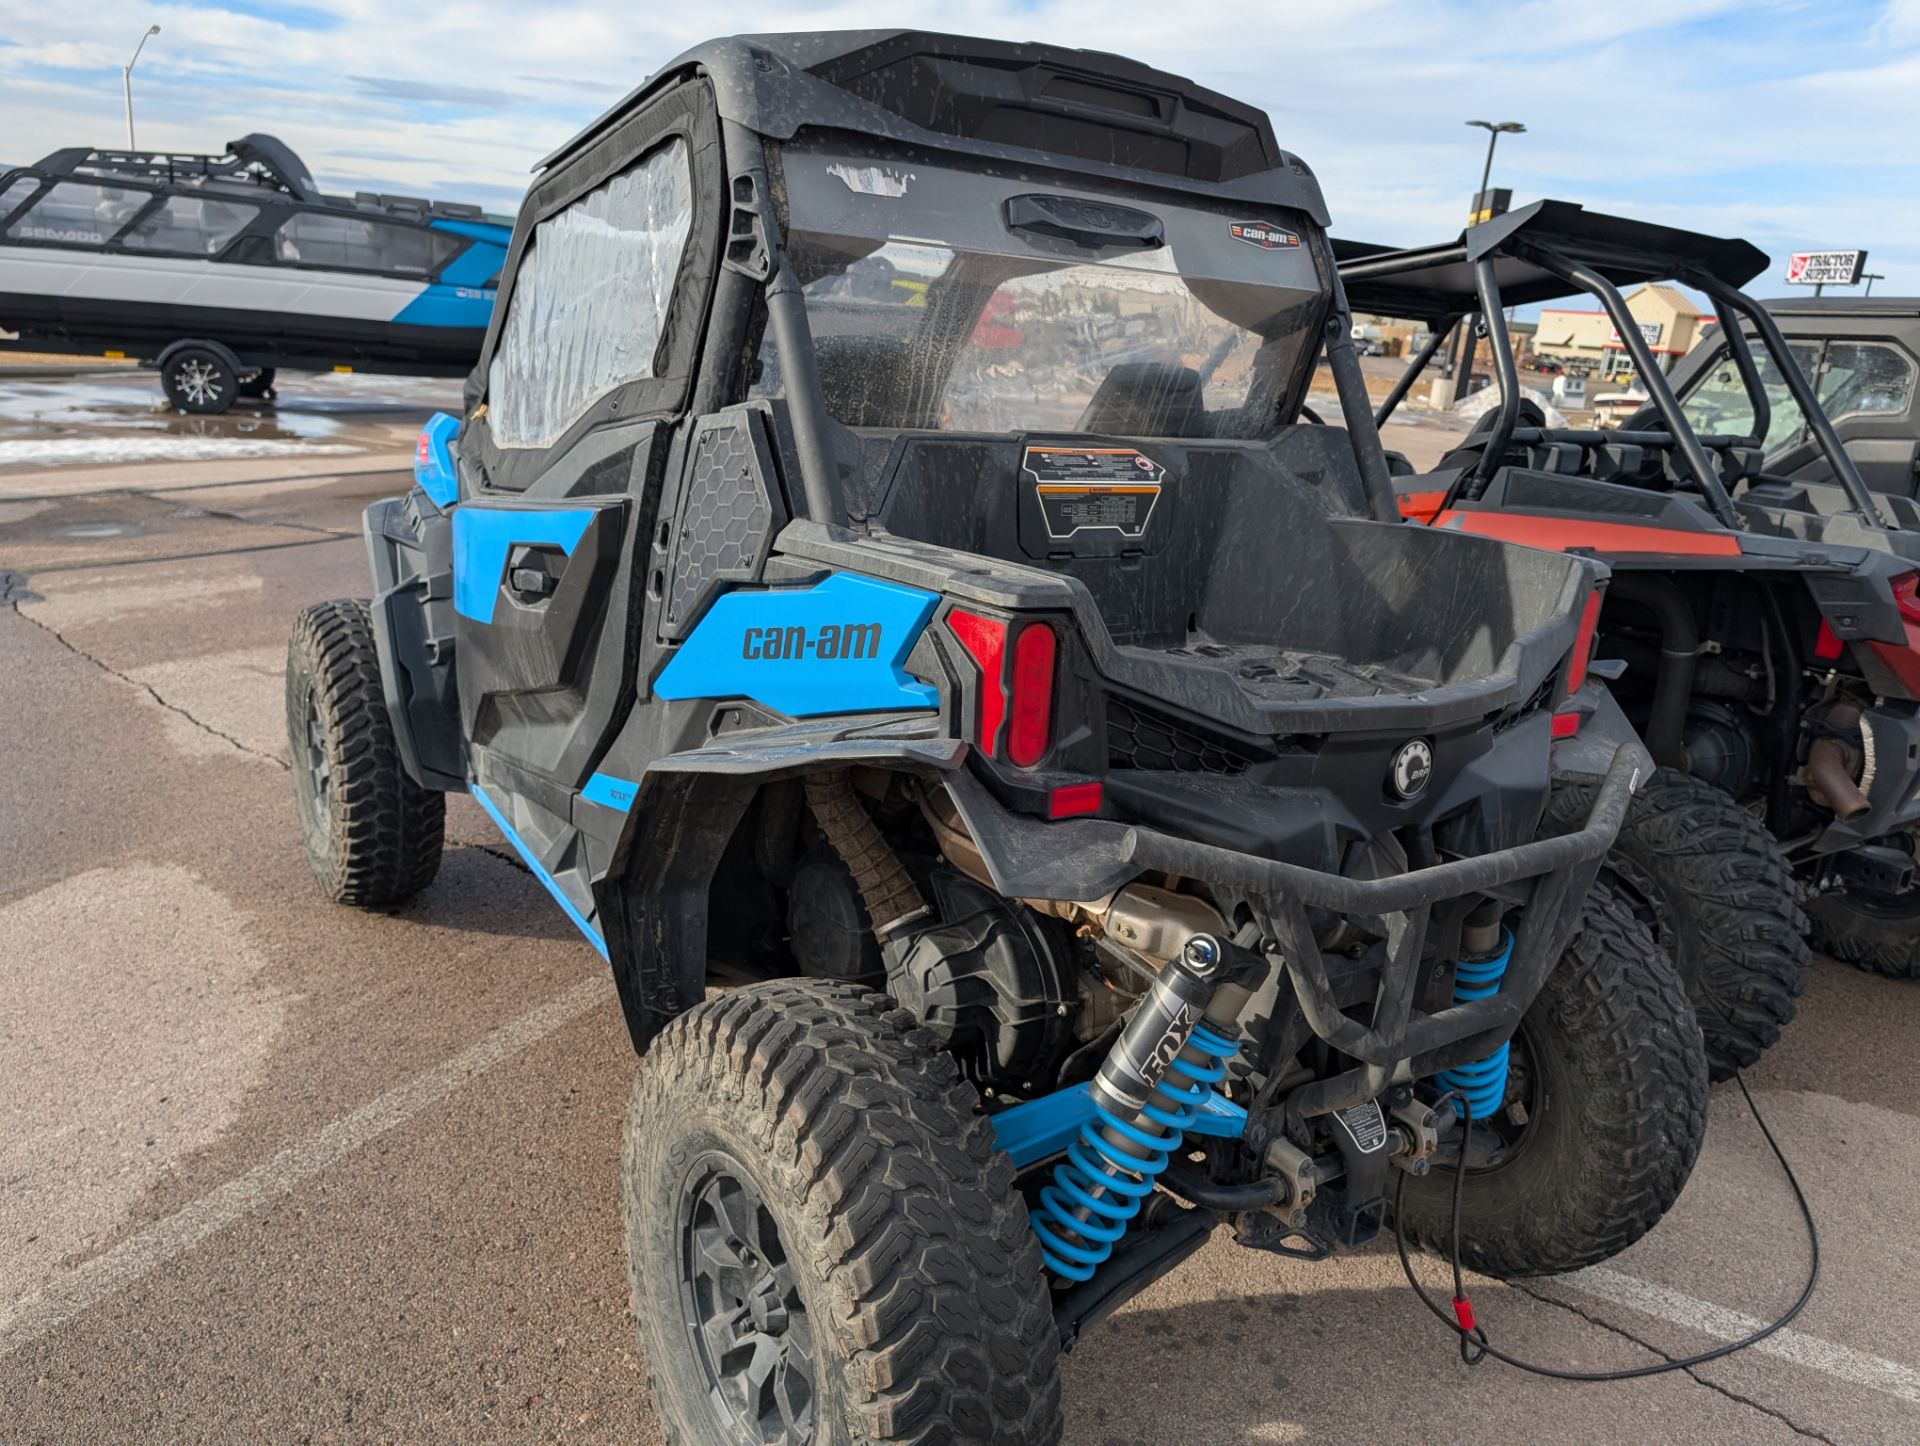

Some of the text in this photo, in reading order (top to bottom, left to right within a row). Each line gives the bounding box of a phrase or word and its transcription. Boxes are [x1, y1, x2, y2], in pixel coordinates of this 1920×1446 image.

[1243, 227, 1288, 243] can-am
[1808, 254, 1855, 267] TRACTOR
[743, 622, 882, 660] can-am
[1411, 767, 1429, 780] BRP
[1139, 1002, 1196, 1088] FOX
